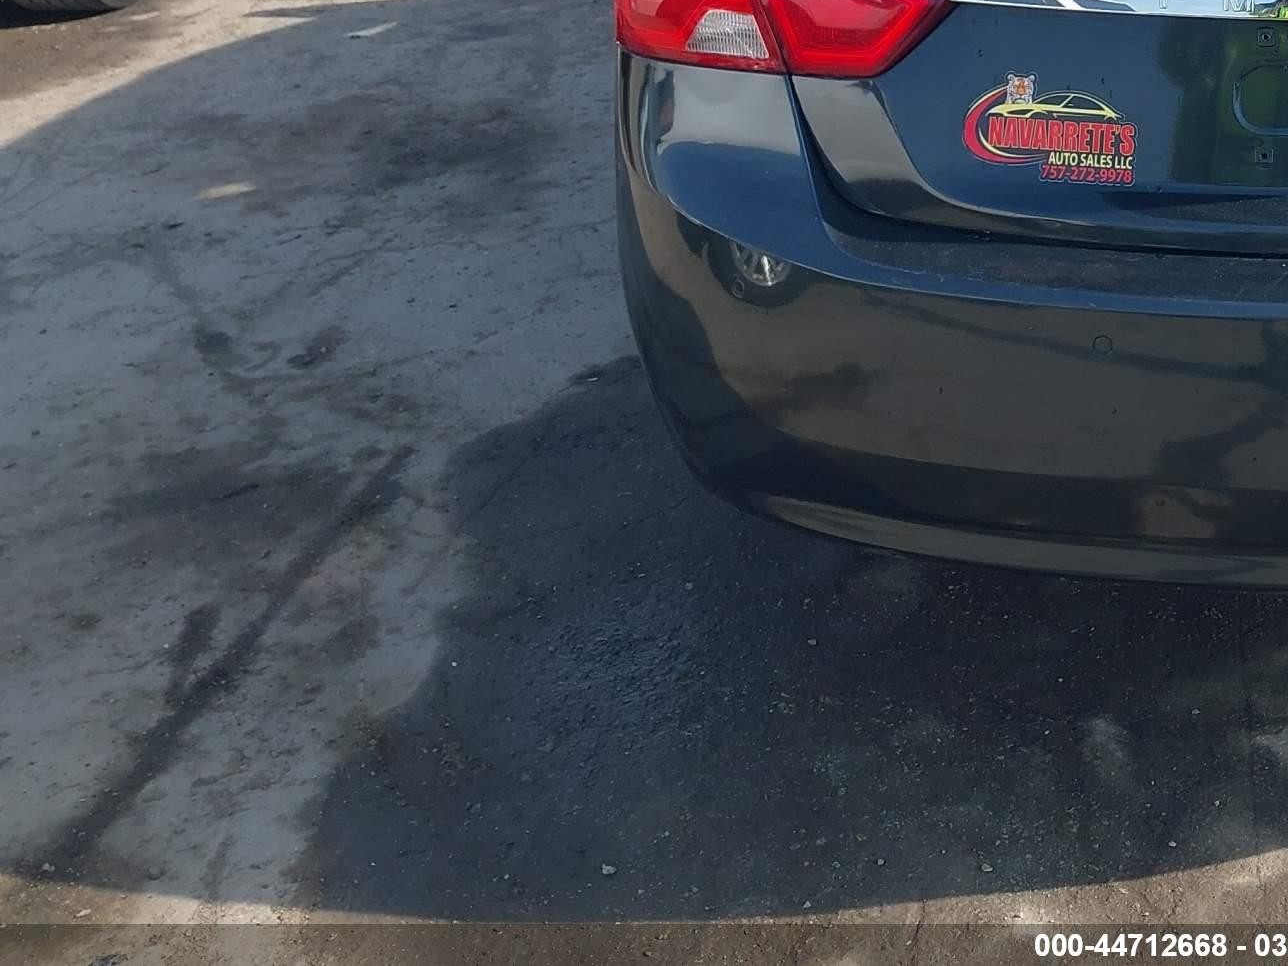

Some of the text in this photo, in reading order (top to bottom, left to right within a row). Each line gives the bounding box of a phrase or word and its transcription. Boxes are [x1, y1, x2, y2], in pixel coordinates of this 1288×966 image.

[988, 116, 1136, 155] NAVARRETE'S
[1048, 152, 1133, 170] AUTO SALES LLC
[1041, 165, 1132, 183] 757-272-9978
